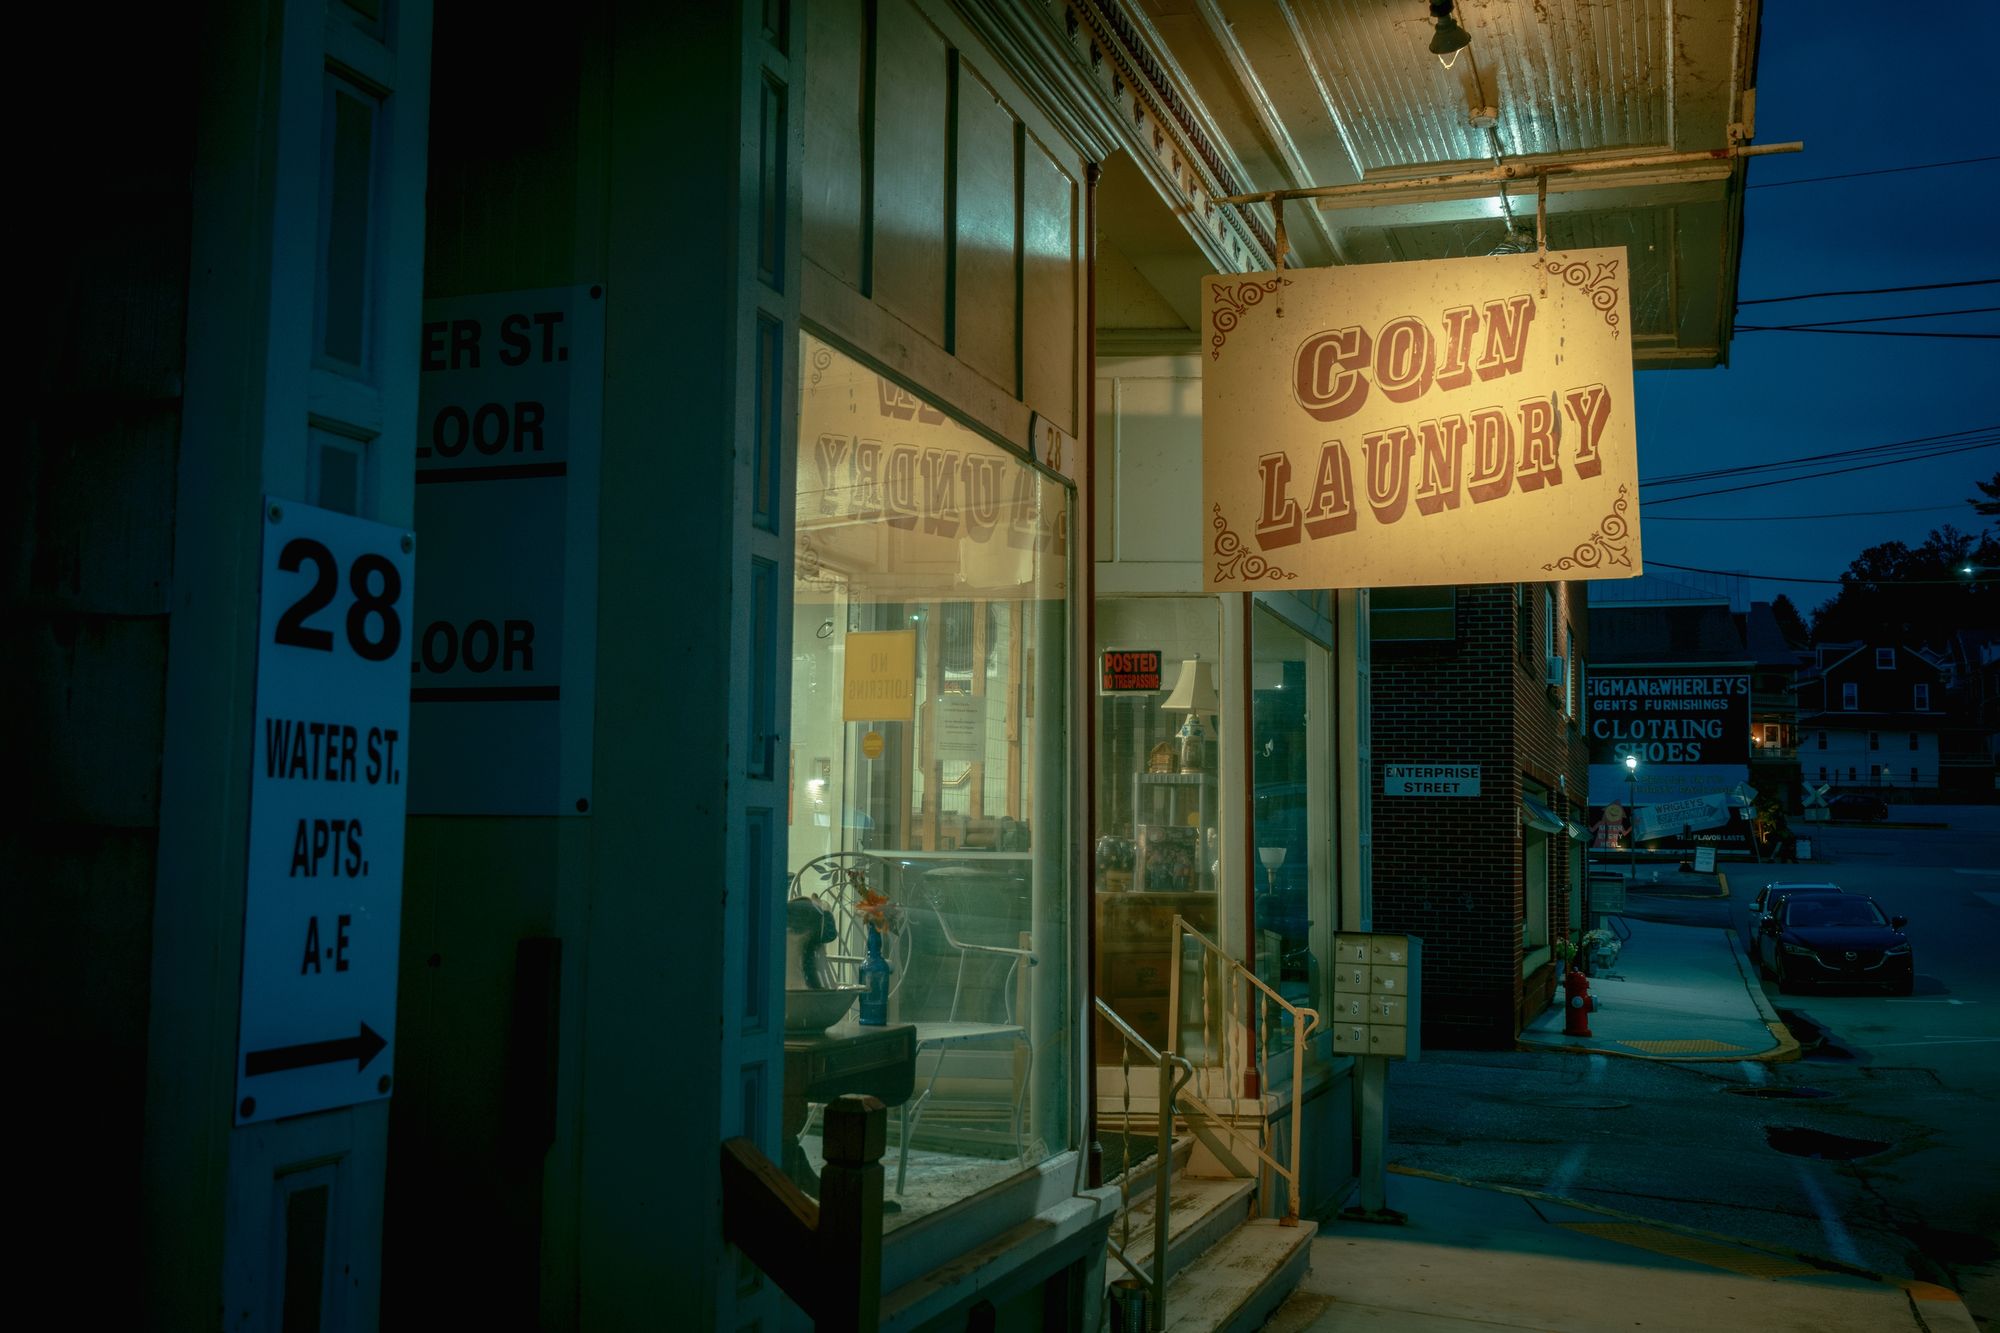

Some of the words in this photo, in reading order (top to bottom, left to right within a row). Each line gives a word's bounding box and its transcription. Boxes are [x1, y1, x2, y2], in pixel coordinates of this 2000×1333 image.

[500, 312, 568, 366] ST.
[1293, 295, 1536, 422] COIN
[1047, 427, 1062, 472] 28
[1255, 383, 1611, 551] LAUNDRY
[275, 538, 401, 661] 28
[412, 619, 534, 673] OOR
[1104, 653, 1157, 672] POSTED
[1103, 674, 1113, 689] NO
[1593, 699, 1638, 711] GENTS
[1645, 699, 1729, 711] FURNISHINGS
[266, 718, 357, 783] WATER
[366, 727, 400, 785] ST.
[1386, 767, 1479, 778] ENTERPRISE
[1614, 742, 1701, 762] SHOES
[1404, 782, 1460, 793] STREET
[289, 817, 369, 879] APTS.
